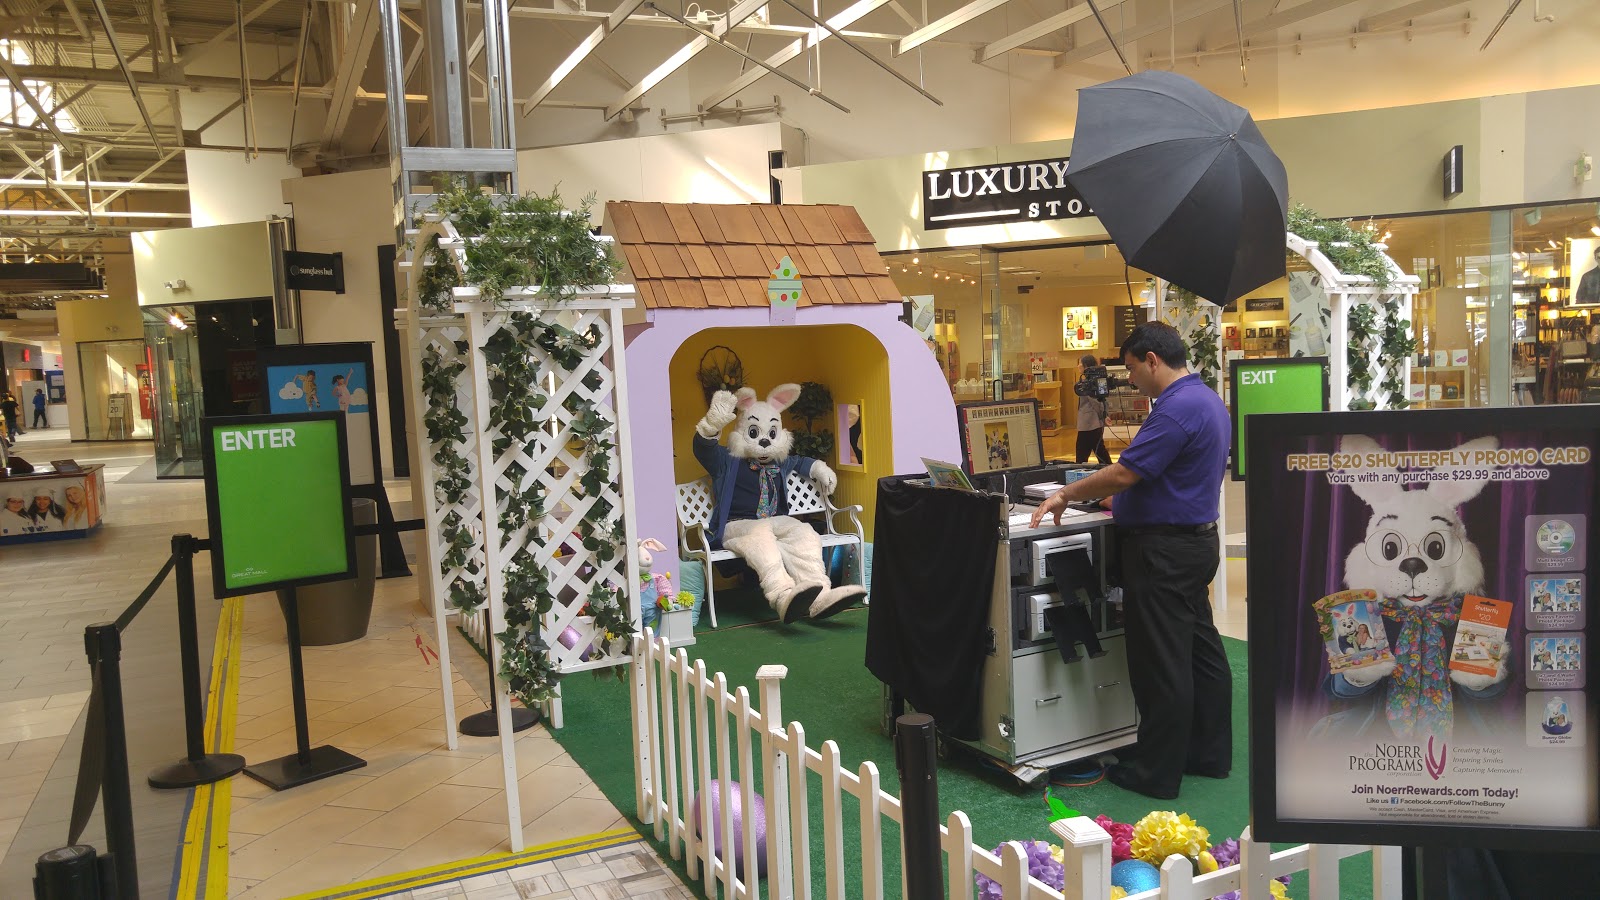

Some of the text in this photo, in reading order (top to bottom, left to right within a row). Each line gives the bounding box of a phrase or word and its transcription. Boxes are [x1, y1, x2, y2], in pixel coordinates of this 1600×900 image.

[928, 160, 1069, 201] LUXURY
[1028, 199, 1094, 218] STO
[300, 267, 333, 276] sunglass hut
[1241, 370, 1277, 385] EXIT
[221, 428, 296, 452] ENTER
[1287, 447, 1591, 470] FREE $20 SHUTTERFLY PROMO CARD
[1327, 468, 1548, 484] Yours with any purchase $29.99 and above
[1452, 746, 1482, 755] Creating
[1349, 756, 1423, 772] PROGRAMS
[1452, 756, 1481, 764] Inspiring
[1452, 766, 1486, 774] Capturing
[1352, 784, 1518, 800] Join NoerrRewards.com Today!
[1400, 798, 1506, 808] Facebook.com/FollowTheBunny
